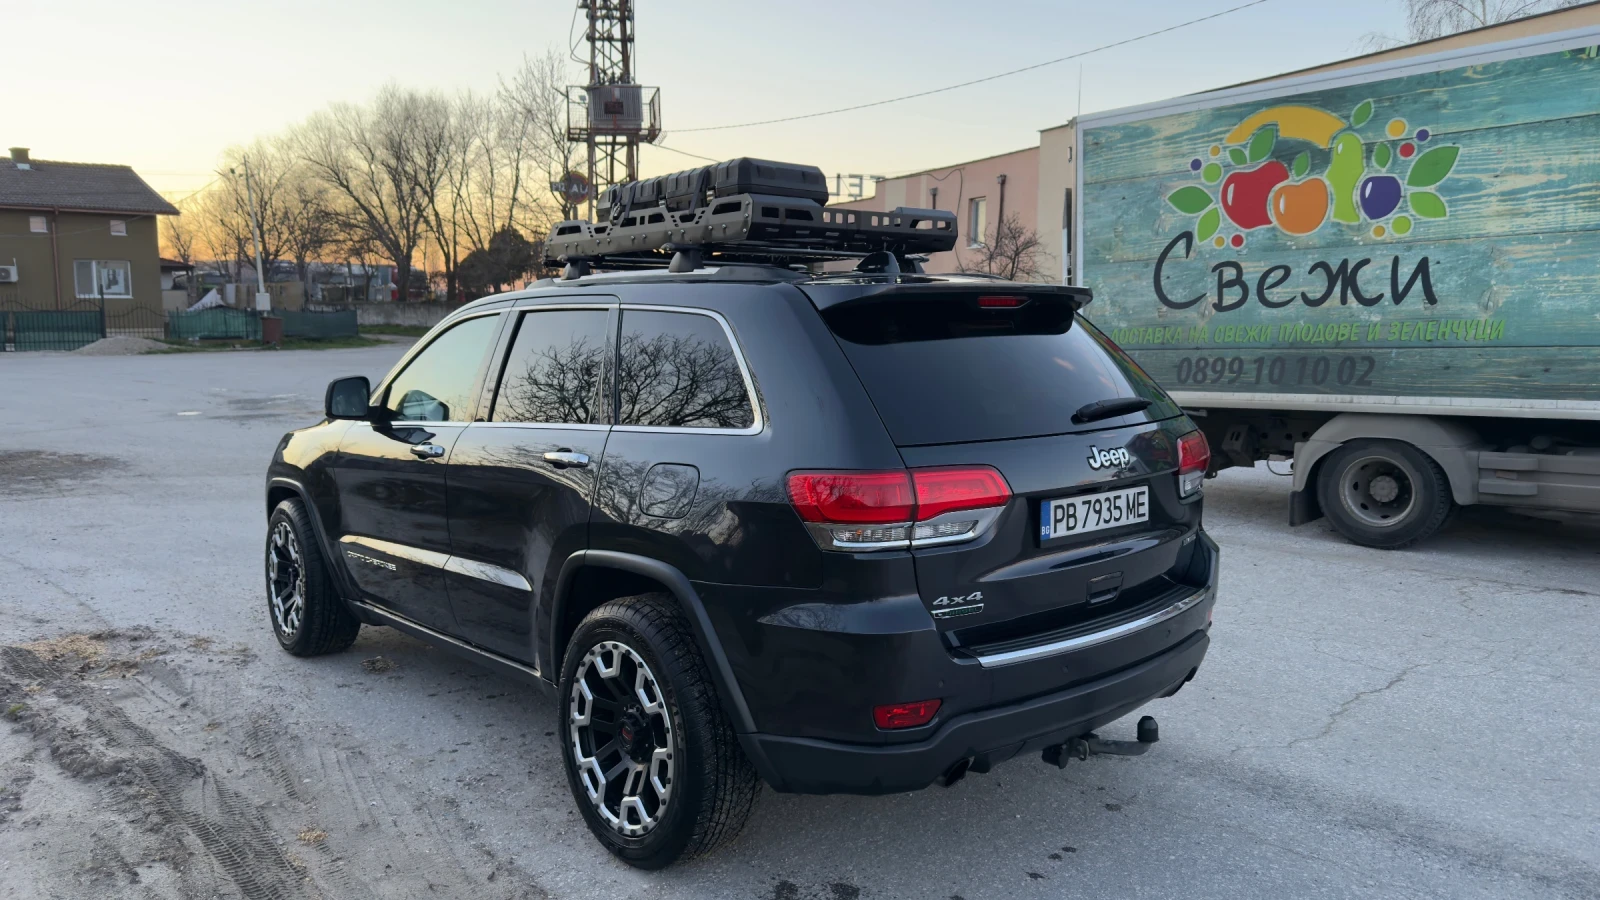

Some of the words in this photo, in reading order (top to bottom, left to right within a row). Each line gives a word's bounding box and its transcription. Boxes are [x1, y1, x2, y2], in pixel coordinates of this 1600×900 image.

[1153, 230, 1438, 313] Свежи
[1111, 326, 1182, 345] ДОСТАВКА
[1188, 325, 1209, 343] НА
[1214, 324, 1273, 344] СВЕЖИ
[1278, 322, 1361, 344] ПЛОДОВЕ
[1367, 322, 1381, 342] И
[1387, 319, 1506, 342] ЗЕЛЕНЧУЦИ
[1176, 356, 1245, 385] 0899
[1253, 356, 1287, 386] 10
[1296, 355, 1331, 386] 10
[1337, 355, 1377, 387] 02
[1087, 445, 1130, 470] Jeep
[1041, 525, 1050, 536] BG
